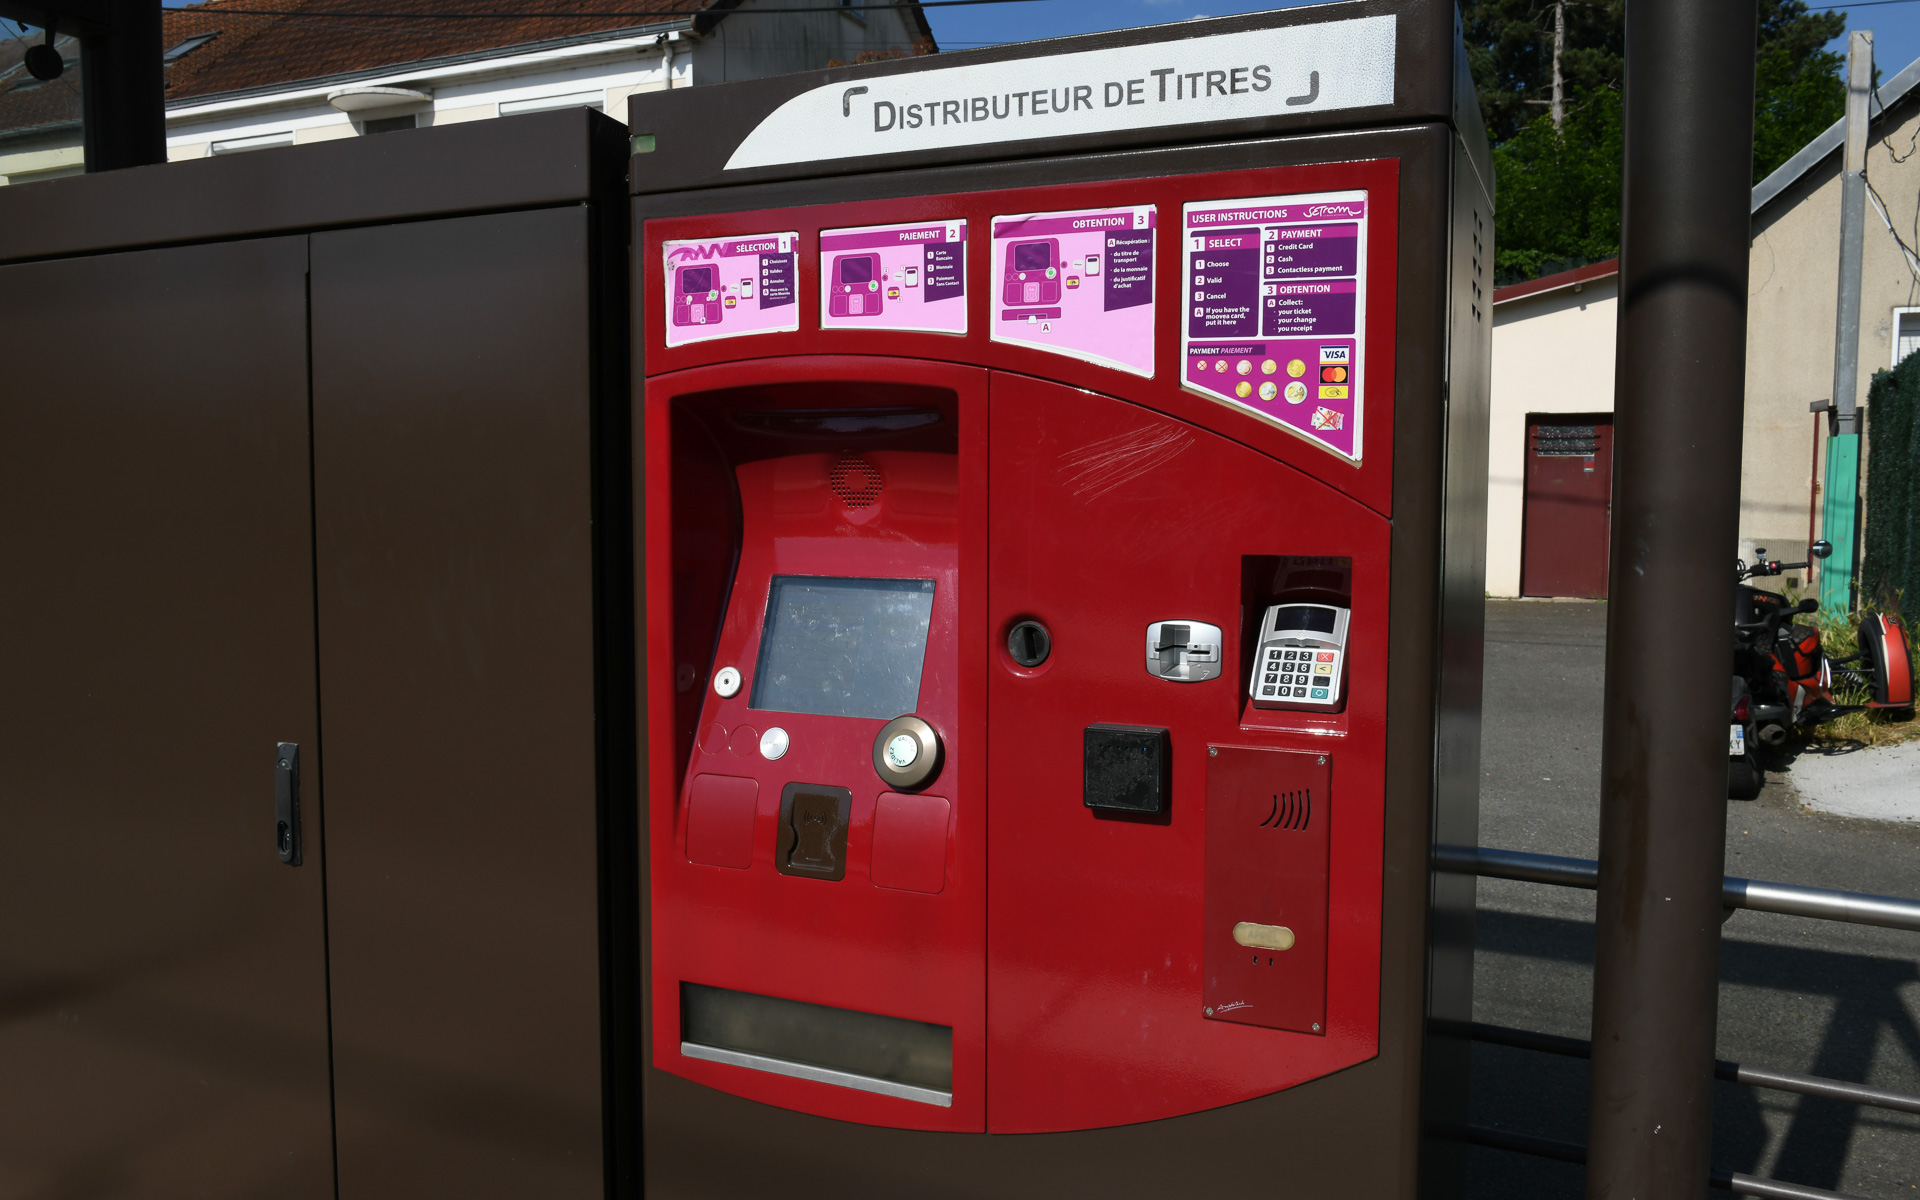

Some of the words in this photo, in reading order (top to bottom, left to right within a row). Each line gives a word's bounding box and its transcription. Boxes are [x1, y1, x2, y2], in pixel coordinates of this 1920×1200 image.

[874, 84, 1093, 132] DISTRIBUTEUR
[1104, 78, 1145, 108] DE
[1150, 65, 1272, 102] TITRES
[1192, 214, 1216, 224] USER
[1217, 209, 1288, 222] INSTRUCTIONS
[1072, 217, 1125, 229] OBTENTION
[1137, 215, 1145, 225] 3
[900, 230, 940, 241] PAIEMENT
[949, 229, 956, 238] 2
[1268, 230, 1275, 239] 2
[1281, 229, 1322, 239] PAYMENT
[736, 242, 776, 253] SÉLECTION
[1208, 238, 1242, 248] SELECT
[1314, 265, 1343, 273] payment
[1267, 286, 1274, 294] 3
[1280, 285, 1331, 294] OBTENTION
[1189, 347, 1220, 355] PAYMENT
[1324, 350, 1346, 359] VISA
[1272, 650, 1278, 659] 1
[1287, 651, 1294, 659] 2
[1302, 652, 1309, 660] 3
[1269, 662, 1276, 670] 4
[1285, 663, 1292, 671] 5
[1301, 664, 1308, 672] 6
[1268, 674, 1275, 682] 7
[1283, 675, 1290, 683] 8
[1298, 676, 1305, 684] 9
[1281, 687, 1288, 695] 0
